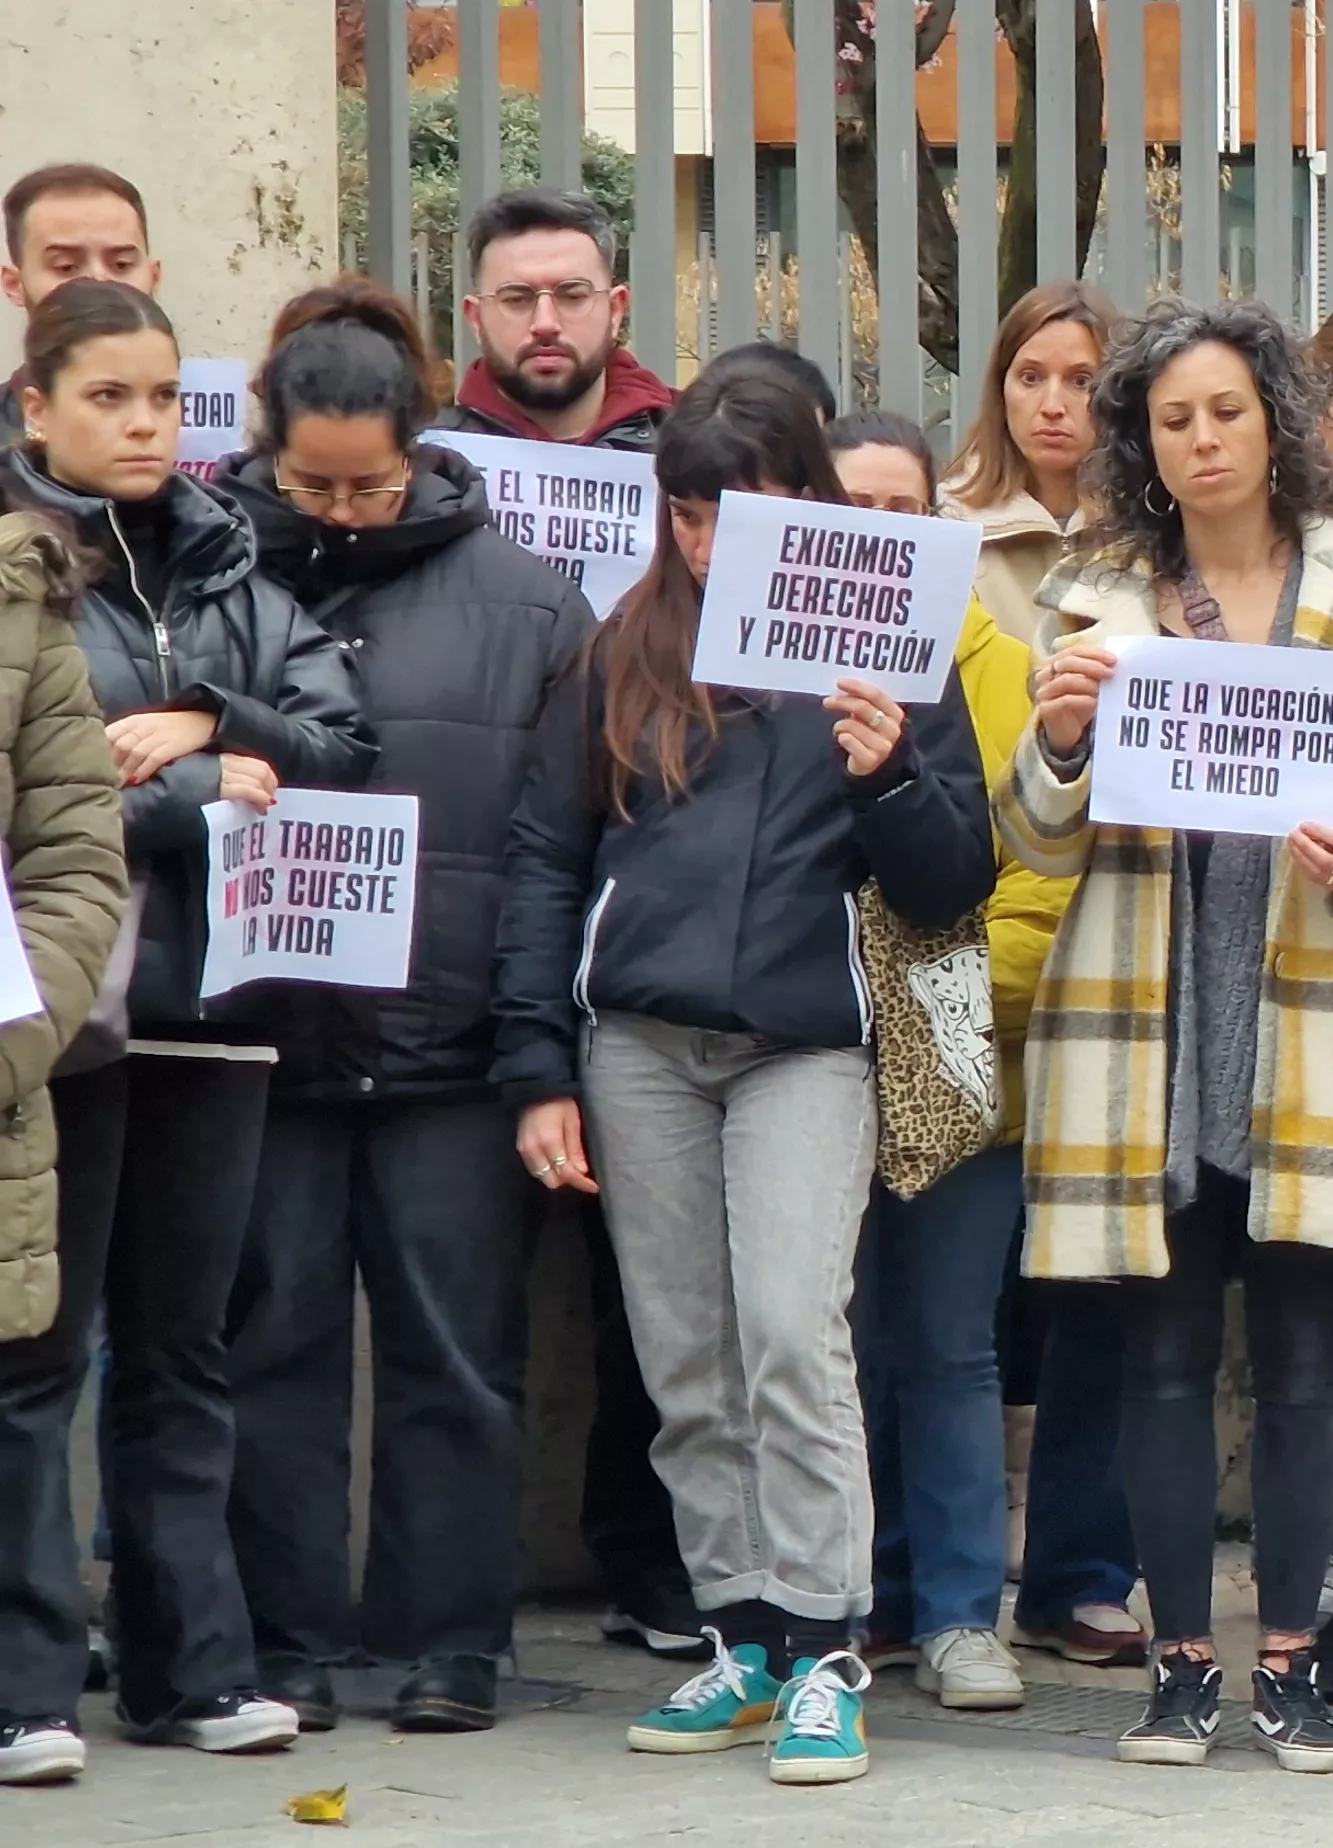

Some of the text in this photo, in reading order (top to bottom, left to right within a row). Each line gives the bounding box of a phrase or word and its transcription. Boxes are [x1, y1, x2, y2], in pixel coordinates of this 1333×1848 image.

[180, 391, 236, 428] EDAD
[498, 468, 643, 520] EL TRABAJO
[546, 514, 637, 557] CUESTE
[779, 523, 917, 579] EXIGIMOS
[766, 571, 913, 626] DERECHOS
[737, 615, 937, 675] Y PROTECCIÓN
[1127, 677, 1174, 712] QUE
[1181, 681, 1210, 715] LA
[1118, 715, 1150, 749] NO
[1159, 718, 1190, 752] SE
[1197, 722, 1282, 760] ROMPA
[1170, 758, 1280, 798] EL MIEDO
[222, 819, 405, 874] QUE EL TRABAJO
[242, 866, 275, 911] NOS
[287, 868, 398, 914] CUESTE
[242, 913, 335, 958] LA VIDA
